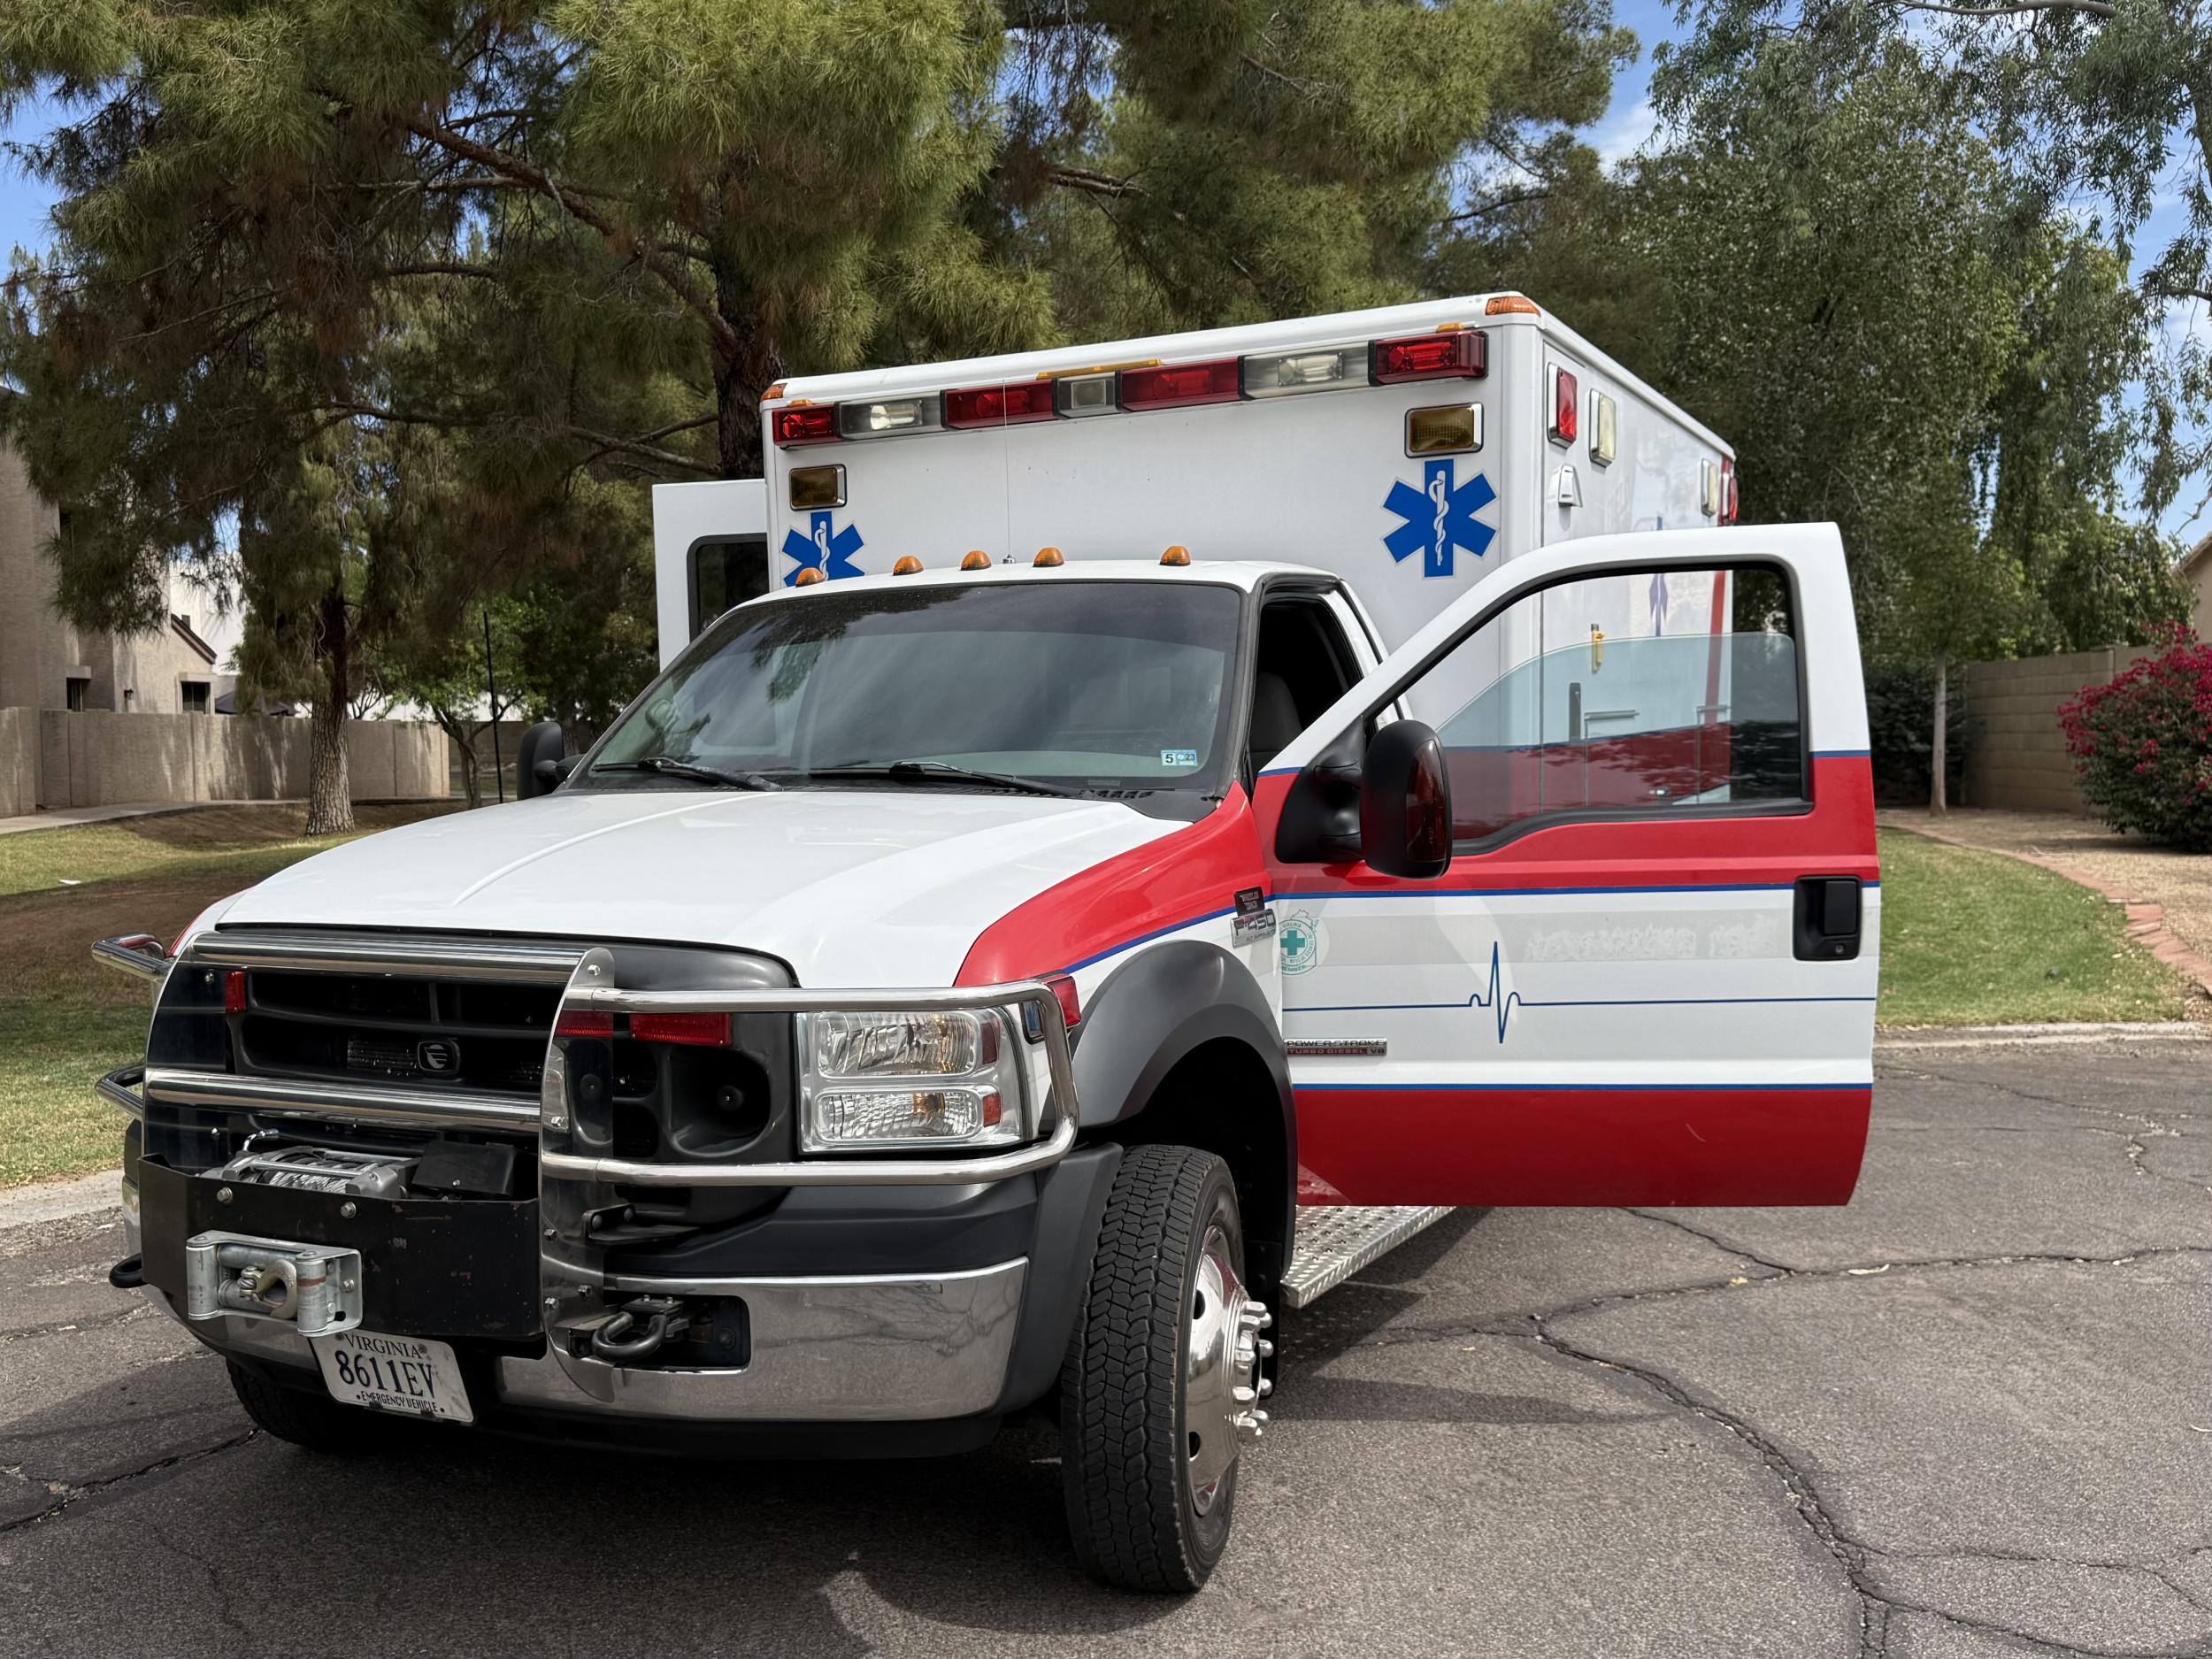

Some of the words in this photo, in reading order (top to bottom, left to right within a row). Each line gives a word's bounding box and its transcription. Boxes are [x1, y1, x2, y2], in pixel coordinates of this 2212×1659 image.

[1165, 753, 1174, 764] 5
[344, 1333, 422, 1359] VIRGINIA
[334, 1349, 435, 1399] 8611EV
[361, 1390, 405, 1408] EMERGENCY
[405, 1396, 438, 1412] VEHICLE
